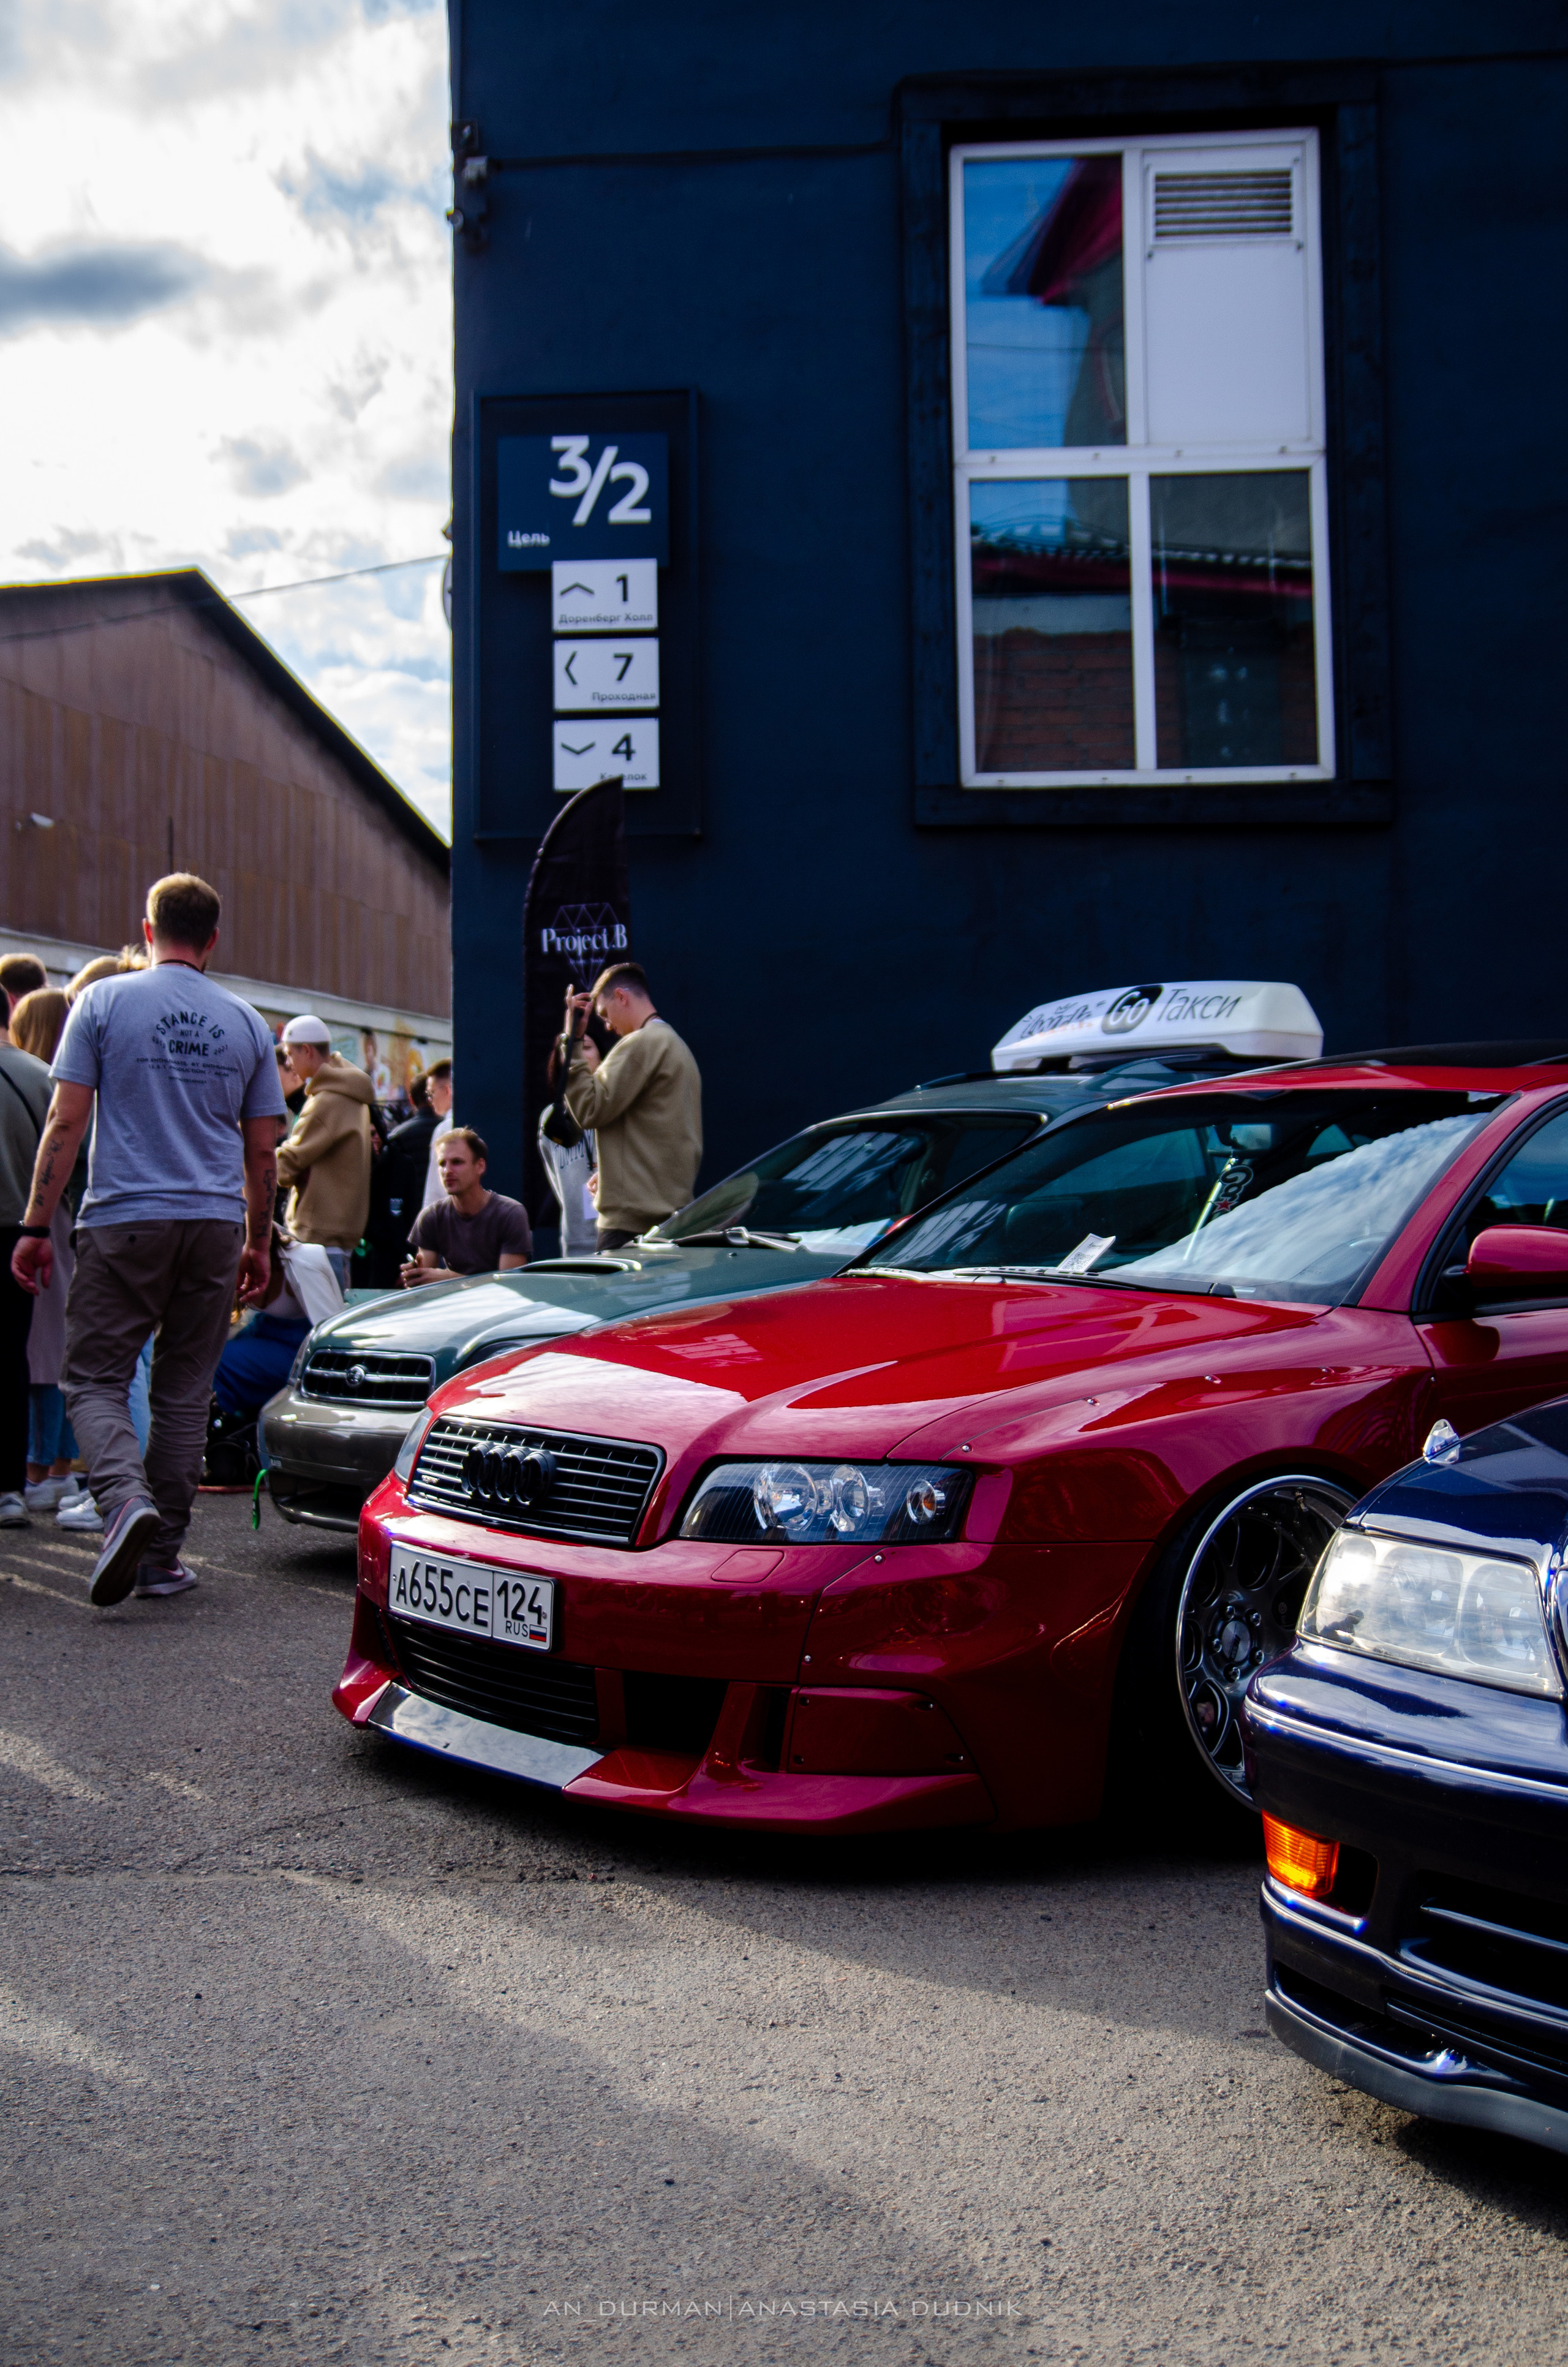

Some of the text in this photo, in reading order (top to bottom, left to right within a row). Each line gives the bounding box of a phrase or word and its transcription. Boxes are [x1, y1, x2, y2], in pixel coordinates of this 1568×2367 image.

[549, 435, 652, 526] 3/2
[508, 530, 550, 547] Цель
[616, 573, 628, 603] 1
[624, 613, 653, 621] Холл
[613, 652, 633, 682] 7
[592, 691, 656, 701] Проходная
[612, 733, 635, 761] 4
[1109, 990, 1151, 1027] Go
[1156, 987, 1242, 1021] Такси
[156, 1011, 225, 1039] STANCE IS
[169, 1039, 209, 1056] CRIME
[497, 1579, 542, 1625] 124
[505, 1620, 529, 1637] RUS
